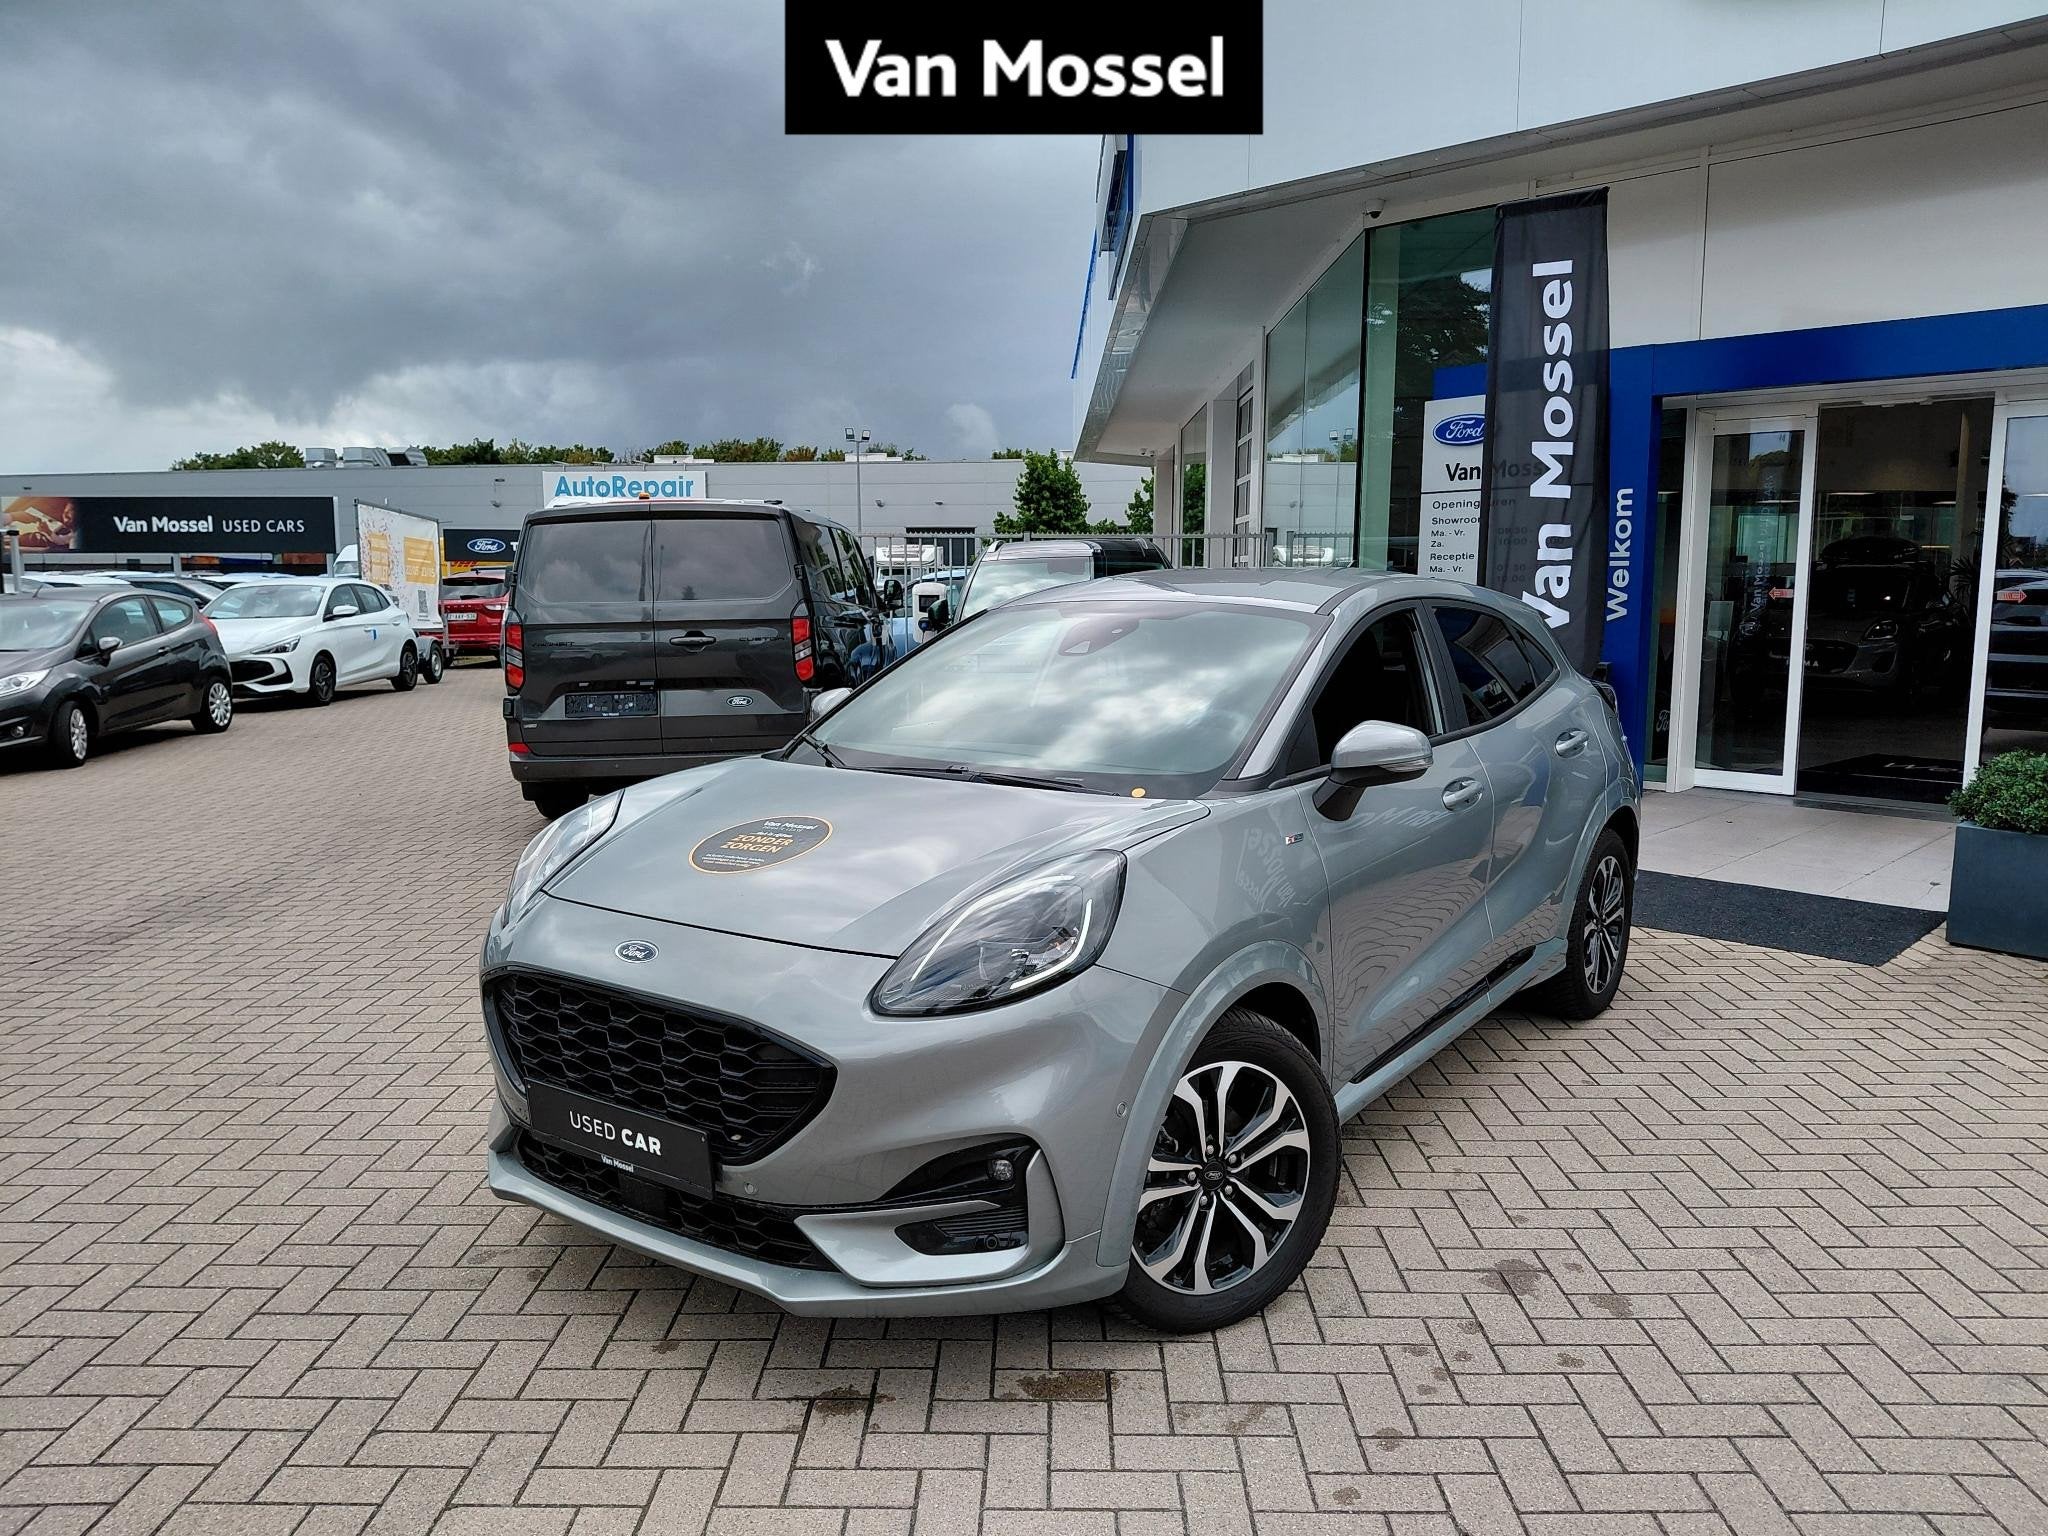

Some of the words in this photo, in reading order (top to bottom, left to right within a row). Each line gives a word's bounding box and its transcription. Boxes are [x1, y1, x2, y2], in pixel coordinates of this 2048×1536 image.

[1528, 259, 1574, 499] Mossel
[1446, 419, 1485, 439] Ford
[1445, 462, 1481, 482] Van
[554, 475, 694, 498] AutoRepair
[113, 516, 148, 533] Van
[151, 515, 213, 533] Mossel
[222, 519, 261, 533] USED
[266, 519, 305, 533] CARS
[1431, 516, 1481, 526] Showroo
[1453, 529, 1466, 537] Vr.
[474, 540, 498, 551] Ford
[1430, 540, 1445, 548] Za.
[1429, 552, 1475, 561] Receptie
[1606, 488, 1633, 622] Welkom
[1521, 522, 1573, 630] Van
[720, 841, 783, 853] ZORGEN
[731, 834, 793, 846] ZONDER
[622, 944, 646, 959] Ford
[568, 1110, 616, 1141] USED
[620, 1128, 662, 1156] CAR
[601, 1154, 613, 1166] Van
[613, 1157, 634, 1173] Mossel
